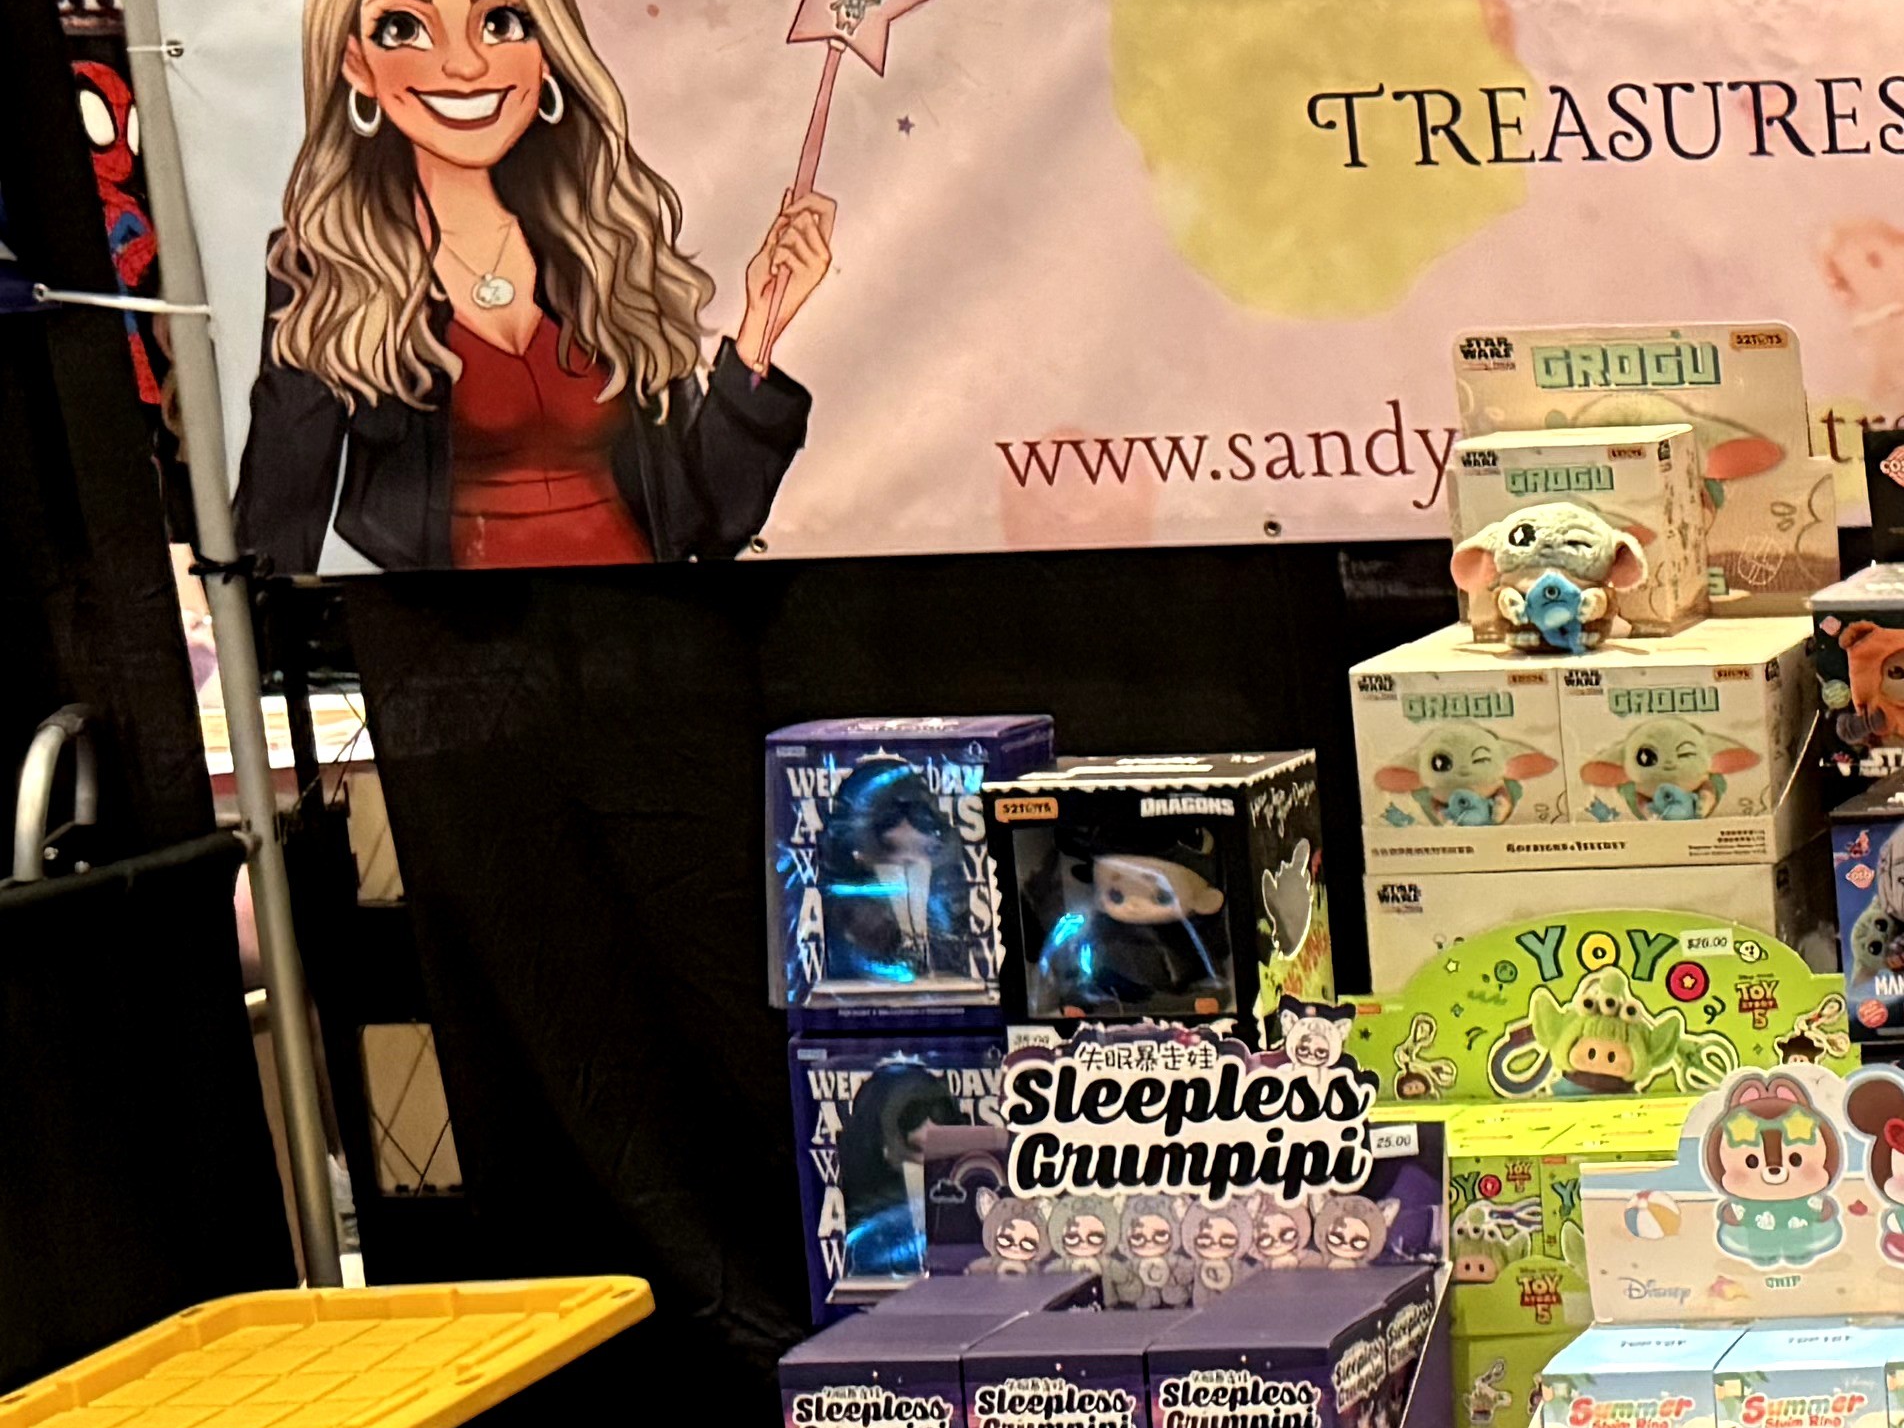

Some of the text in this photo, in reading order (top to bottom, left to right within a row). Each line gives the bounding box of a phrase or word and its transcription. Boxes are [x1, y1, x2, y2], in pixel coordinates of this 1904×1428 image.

[1531, 341, 1722, 389] GROGU
[1505, 465, 1615, 494] GROGU
[1402, 691, 1514, 721] GROGU
[1608, 686, 1720, 717] GROGU
[1140, 797, 1235, 818] DRAGONS
[1735, 980, 1780, 1000] TOY
[1077, 1043, 1216, 1072] 失眠暴走娃
[1007, 1061, 1371, 1138] Sleepless
[1376, 1134, 1412, 1149] 25.00
[1016, 1127, 1363, 1201] Grumpipi
[1516, 1273, 1563, 1296] TOY
[1617, 1275, 1692, 1305] Disney
[1535, 1303, 1553, 1325] 5
[795, 1393, 951, 1428] Sleepless
[976, 1386, 1134, 1421] Sleepless
[1160, 1379, 1320, 1414] Sleepless
[1569, 1395, 1695, 1426] Summer
[1741, 1391, 1866, 1424] Summer
